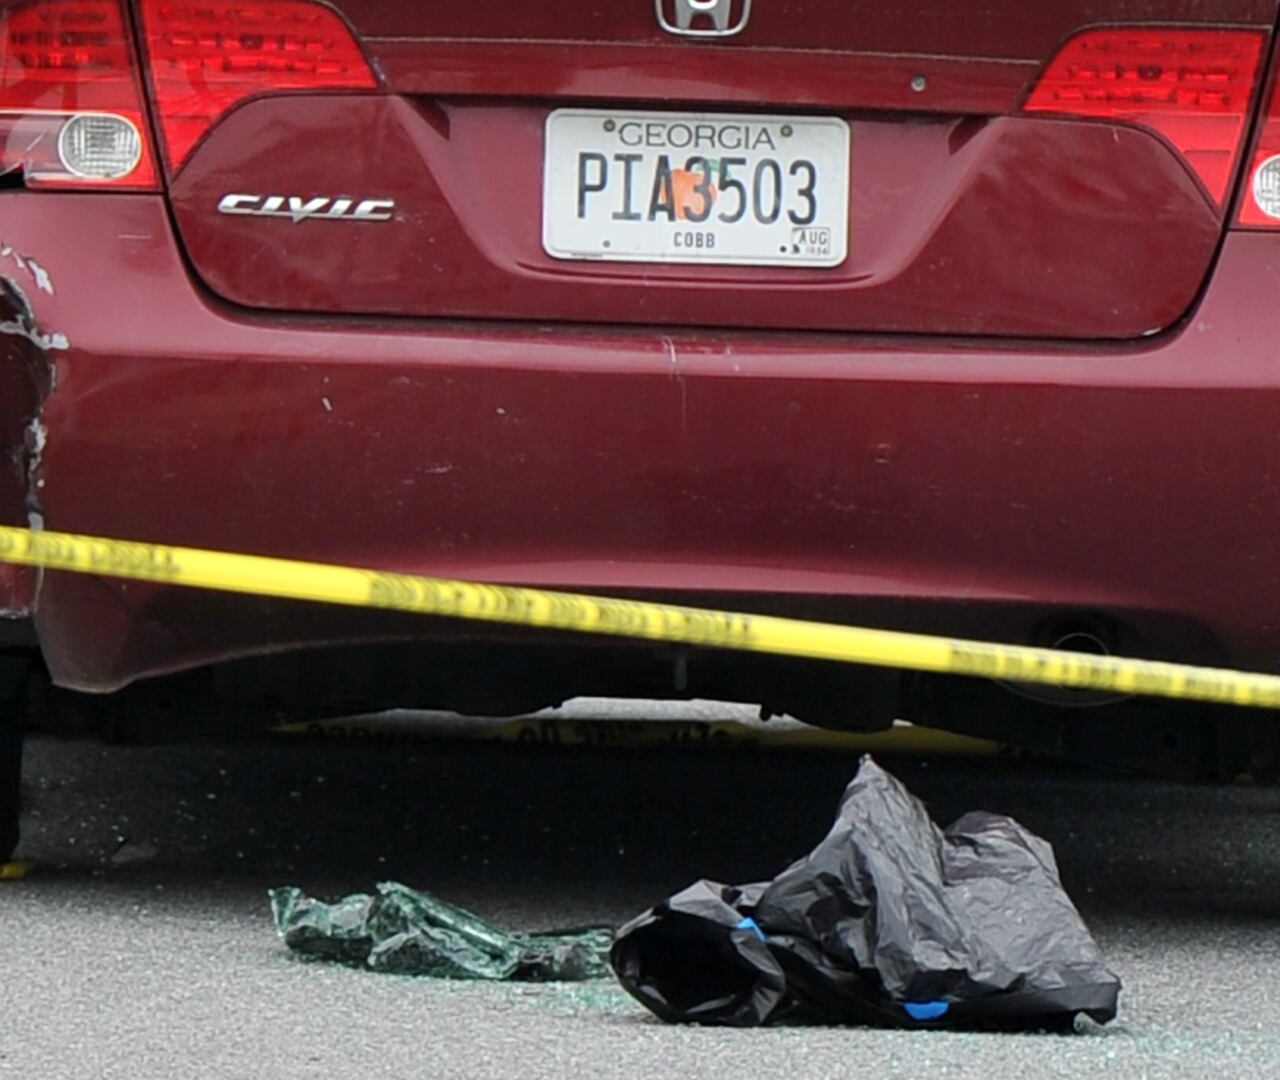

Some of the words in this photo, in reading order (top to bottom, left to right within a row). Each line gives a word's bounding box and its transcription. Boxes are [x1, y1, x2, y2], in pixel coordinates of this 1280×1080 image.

[619, 121, 777, 151] GEORGIA
[576, 151, 817, 226] PIA3503
[218, 193, 395, 224] CIVIC
[673, 231, 717, 249] COBB
[798, 229, 828, 245] AUG
